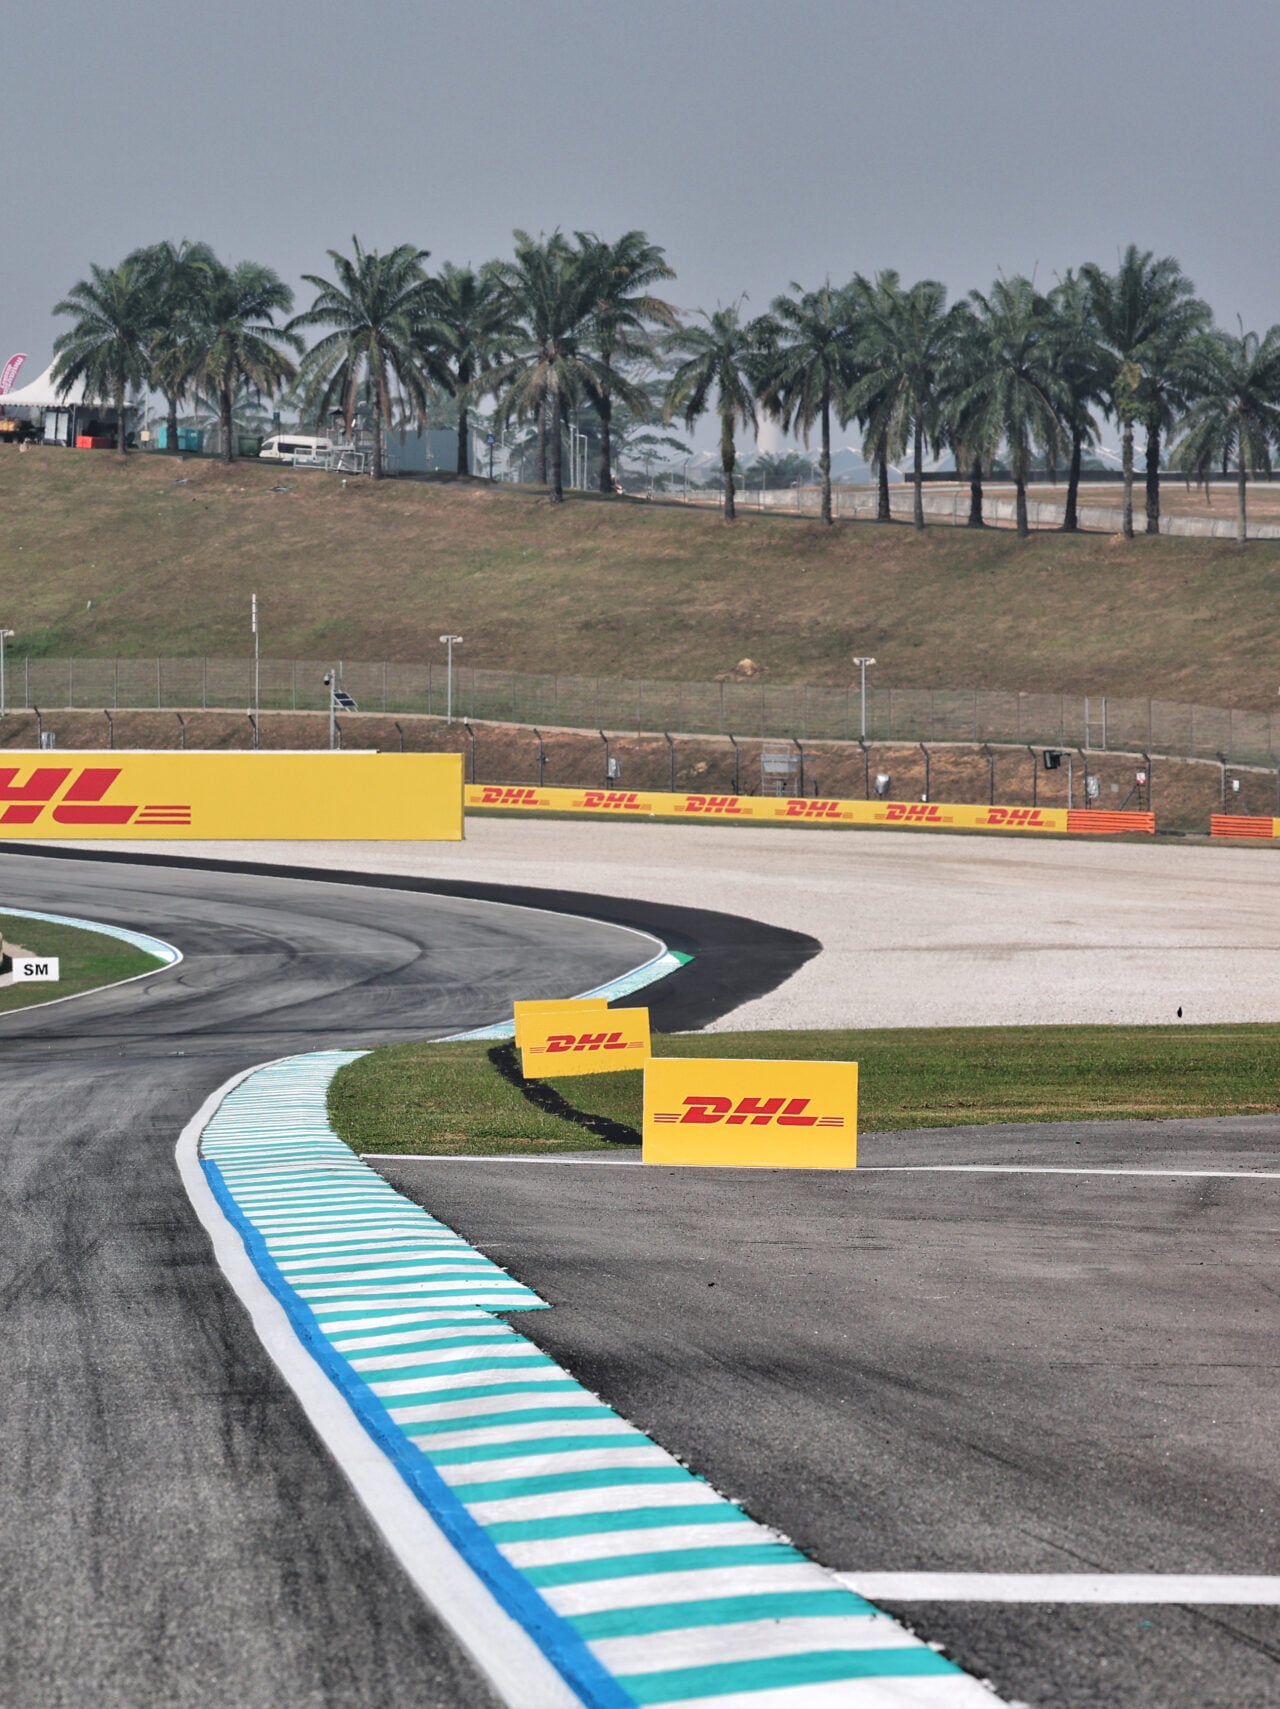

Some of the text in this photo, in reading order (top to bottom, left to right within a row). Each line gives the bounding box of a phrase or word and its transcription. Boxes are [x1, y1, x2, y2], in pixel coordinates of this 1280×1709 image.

[481, 787, 538, 805] DHL
[583, 792, 640, 809] DHL
[684, 796, 742, 814] DHL
[785, 800, 842, 818] DHL
[886, 804, 942, 822] DHL
[986, 808, 1044, 827] DHL
[23, 964, 49, 976] SM
[545, 1032, 627, 1053] DHL
[679, 1096, 818, 1127] DHL
